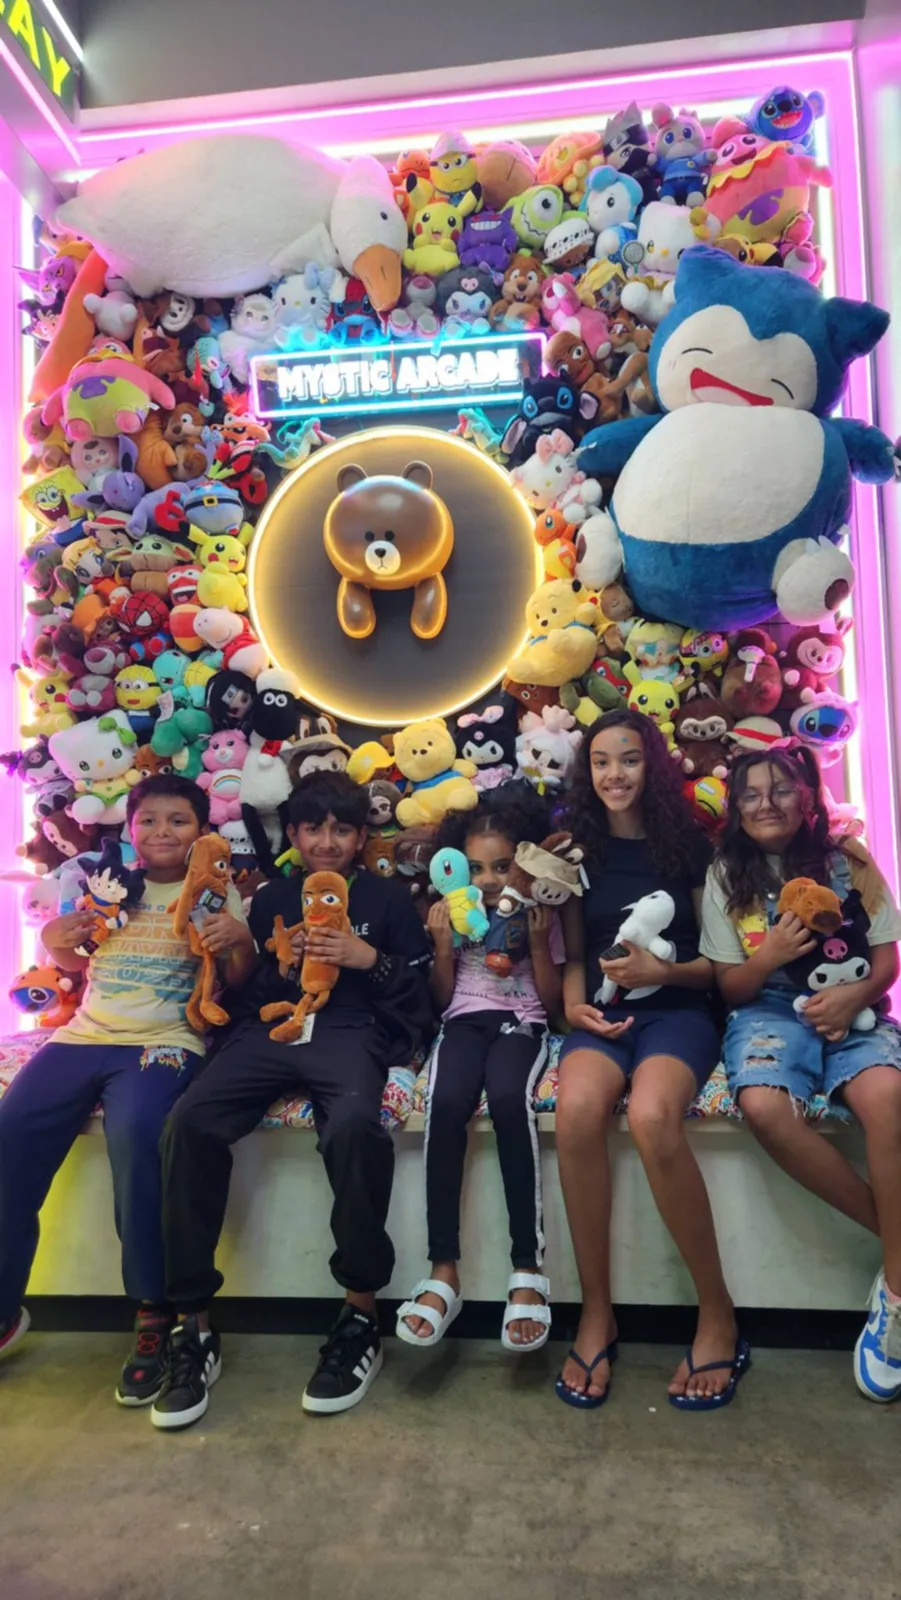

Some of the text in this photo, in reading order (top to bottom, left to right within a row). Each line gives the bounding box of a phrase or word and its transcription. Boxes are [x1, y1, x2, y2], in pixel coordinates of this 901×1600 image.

[0, 0, 72, 97] AY
[277, 348, 521, 401] MYSTIC ARCADE
